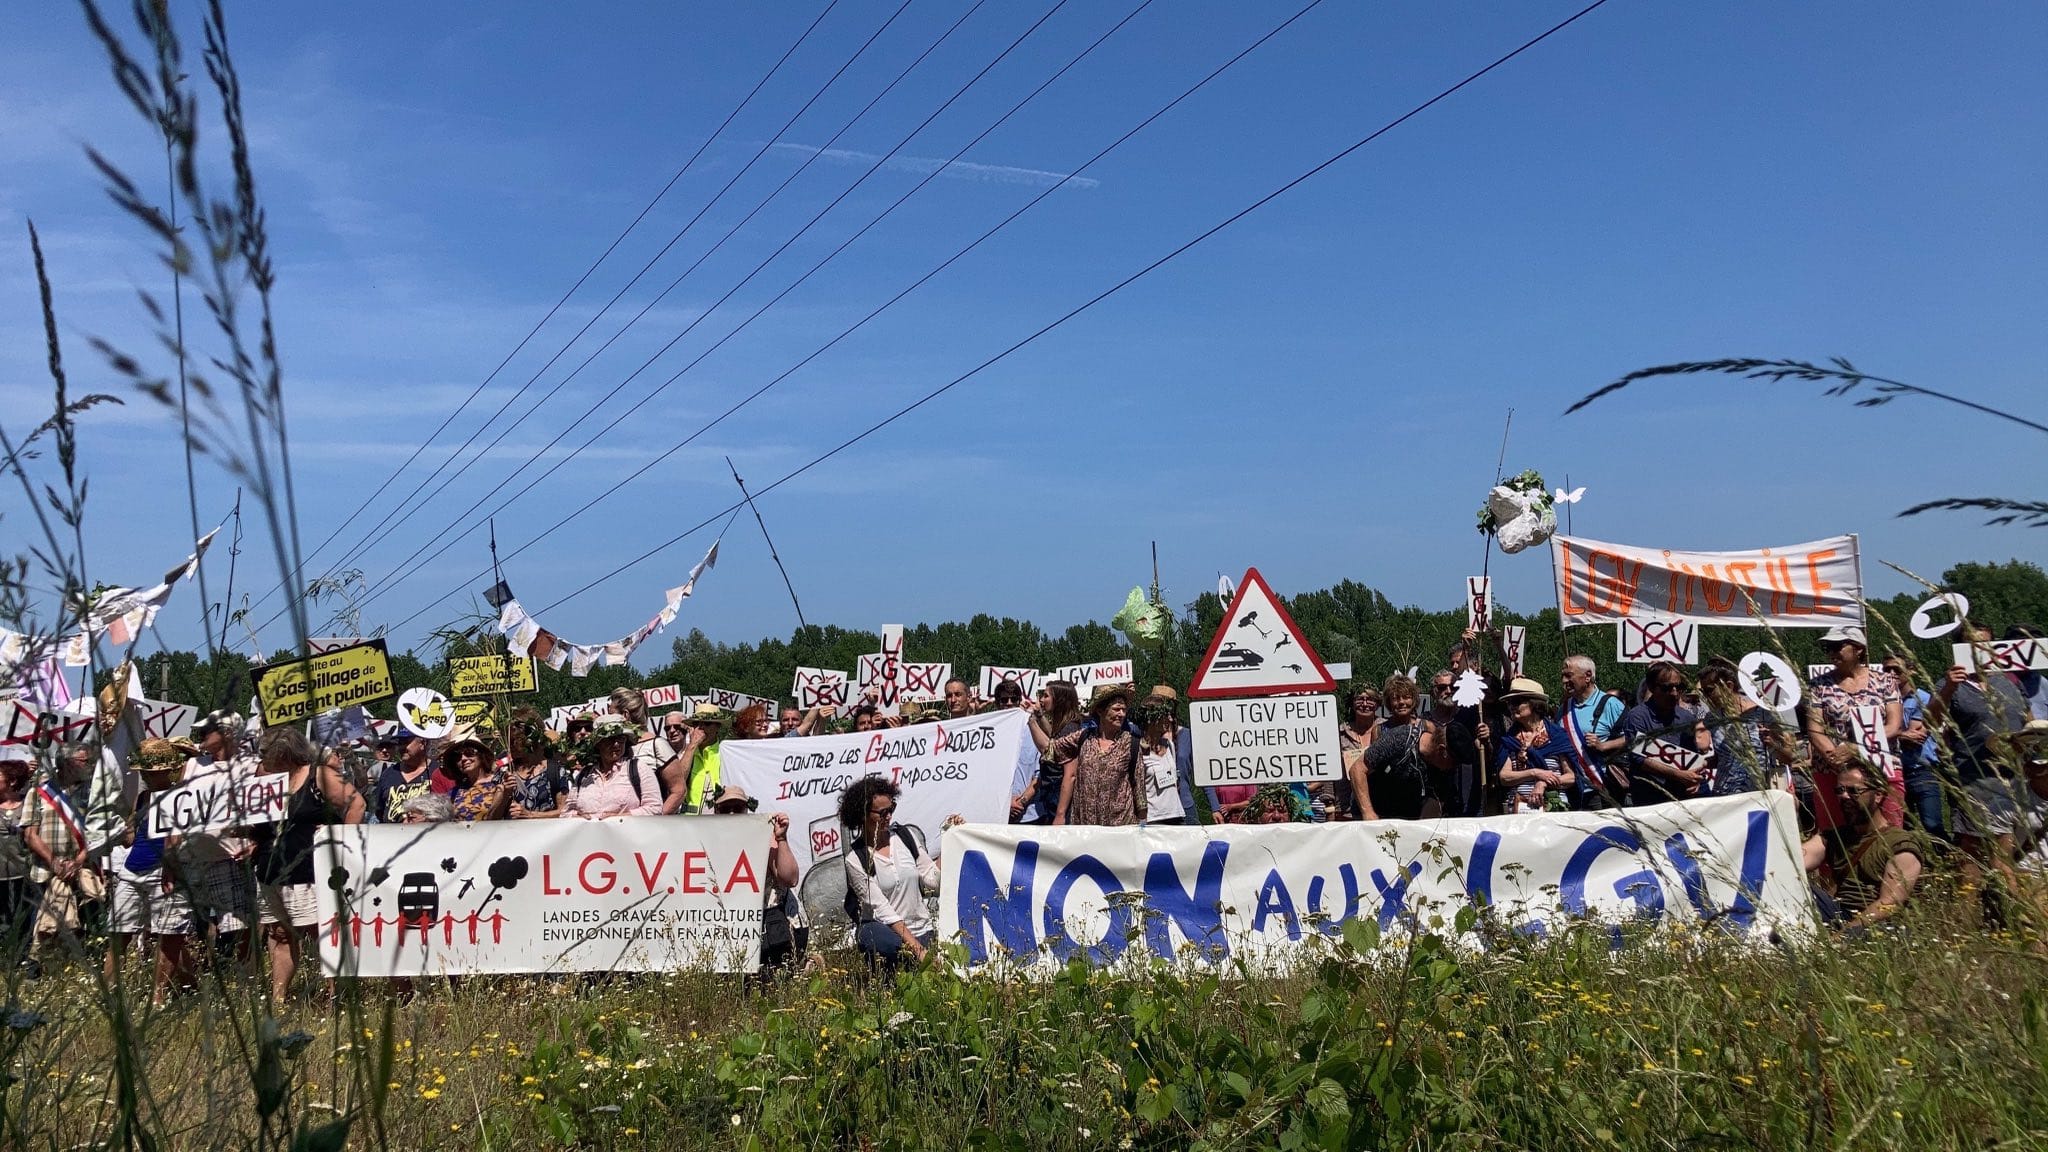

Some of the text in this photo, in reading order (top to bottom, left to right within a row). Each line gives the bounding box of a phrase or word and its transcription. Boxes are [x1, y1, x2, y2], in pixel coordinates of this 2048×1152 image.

[1563, 541, 1642, 615] LGV
[1622, 620, 1693, 662] LGV
[307, 657, 343, 674] alte au
[363, 665, 376, 676] de
[494, 655, 523, 667] Trin
[881, 633, 899, 708] LGV
[803, 683, 849, 708] LGV
[1200, 701, 1328, 723] UN TGV PEUT
[1219, 727, 1319, 748] CACHER UN
[1209, 753, 1328, 781] DESASTRE
[156, 780, 283, 834] LGV NON
[812, 828, 839, 853] STOP
[543, 849, 760, 896] L.G.V.E.A
[957, 810, 1770, 966] NON AUX LGV
[543, 909, 762, 923] LANDES GRAVES VITICULTURE
[543, 927, 672, 941] ENVIRONNEMENT
